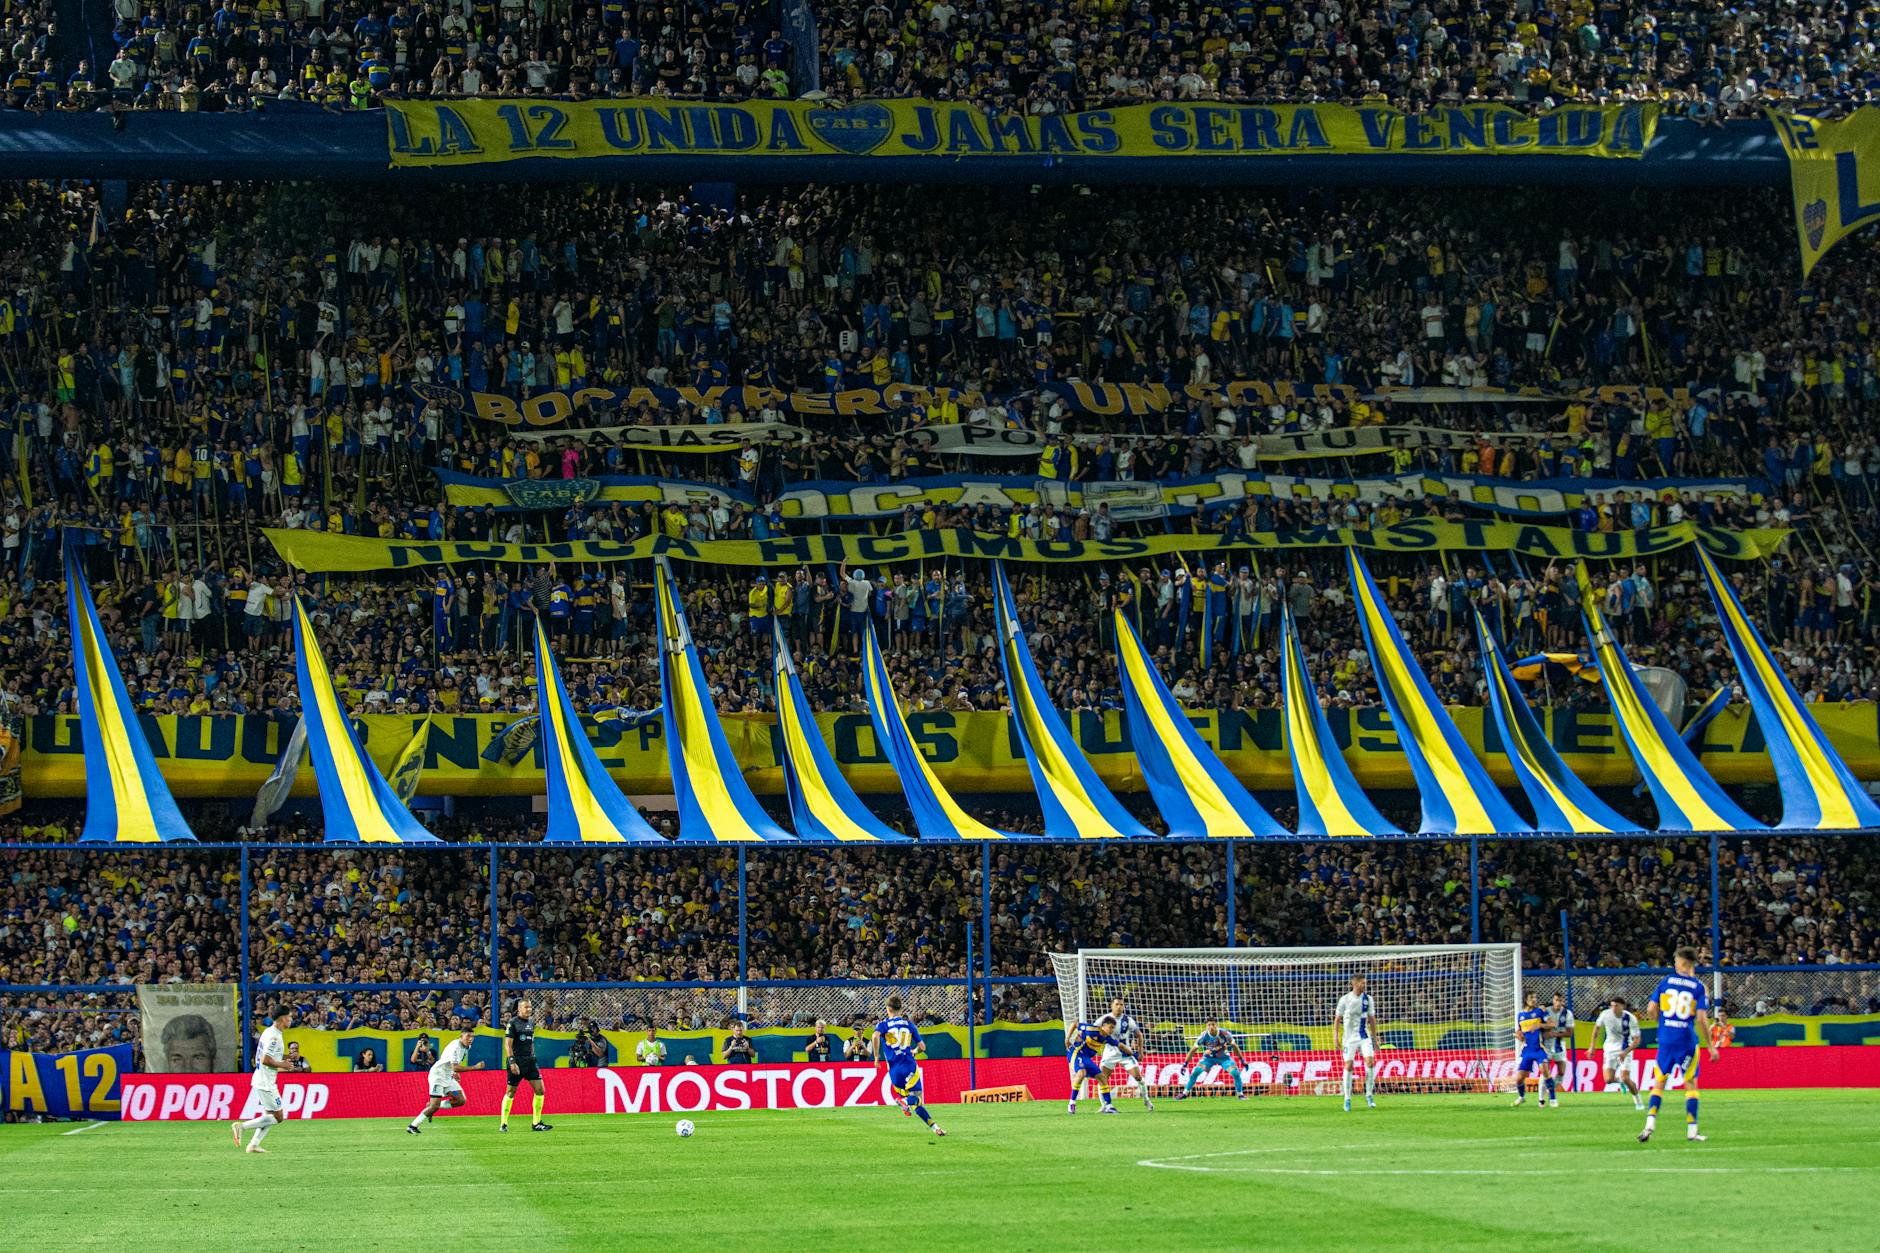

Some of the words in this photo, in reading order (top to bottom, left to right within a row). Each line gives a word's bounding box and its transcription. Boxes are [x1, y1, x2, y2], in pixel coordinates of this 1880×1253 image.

[393, 104, 482, 153] LA
[501, 105, 575, 151] 12
[597, 106, 812, 152] UNIDA
[901, 106, 1121, 154] JAMAS
[1150, 105, 1333, 152] SERA
[1357, 103, 1647, 152] VENCIDA
[1072, 381, 1172, 416] UN
[388, 534, 700, 566] NUNCA
[759, 528, 1148, 563] HICIMOS
[1663, 988, 1693, 1020] 38
[0, 1051, 48, 1112] A
[56, 1053, 121, 1112] 12
[160, 1084, 235, 1120] POR
